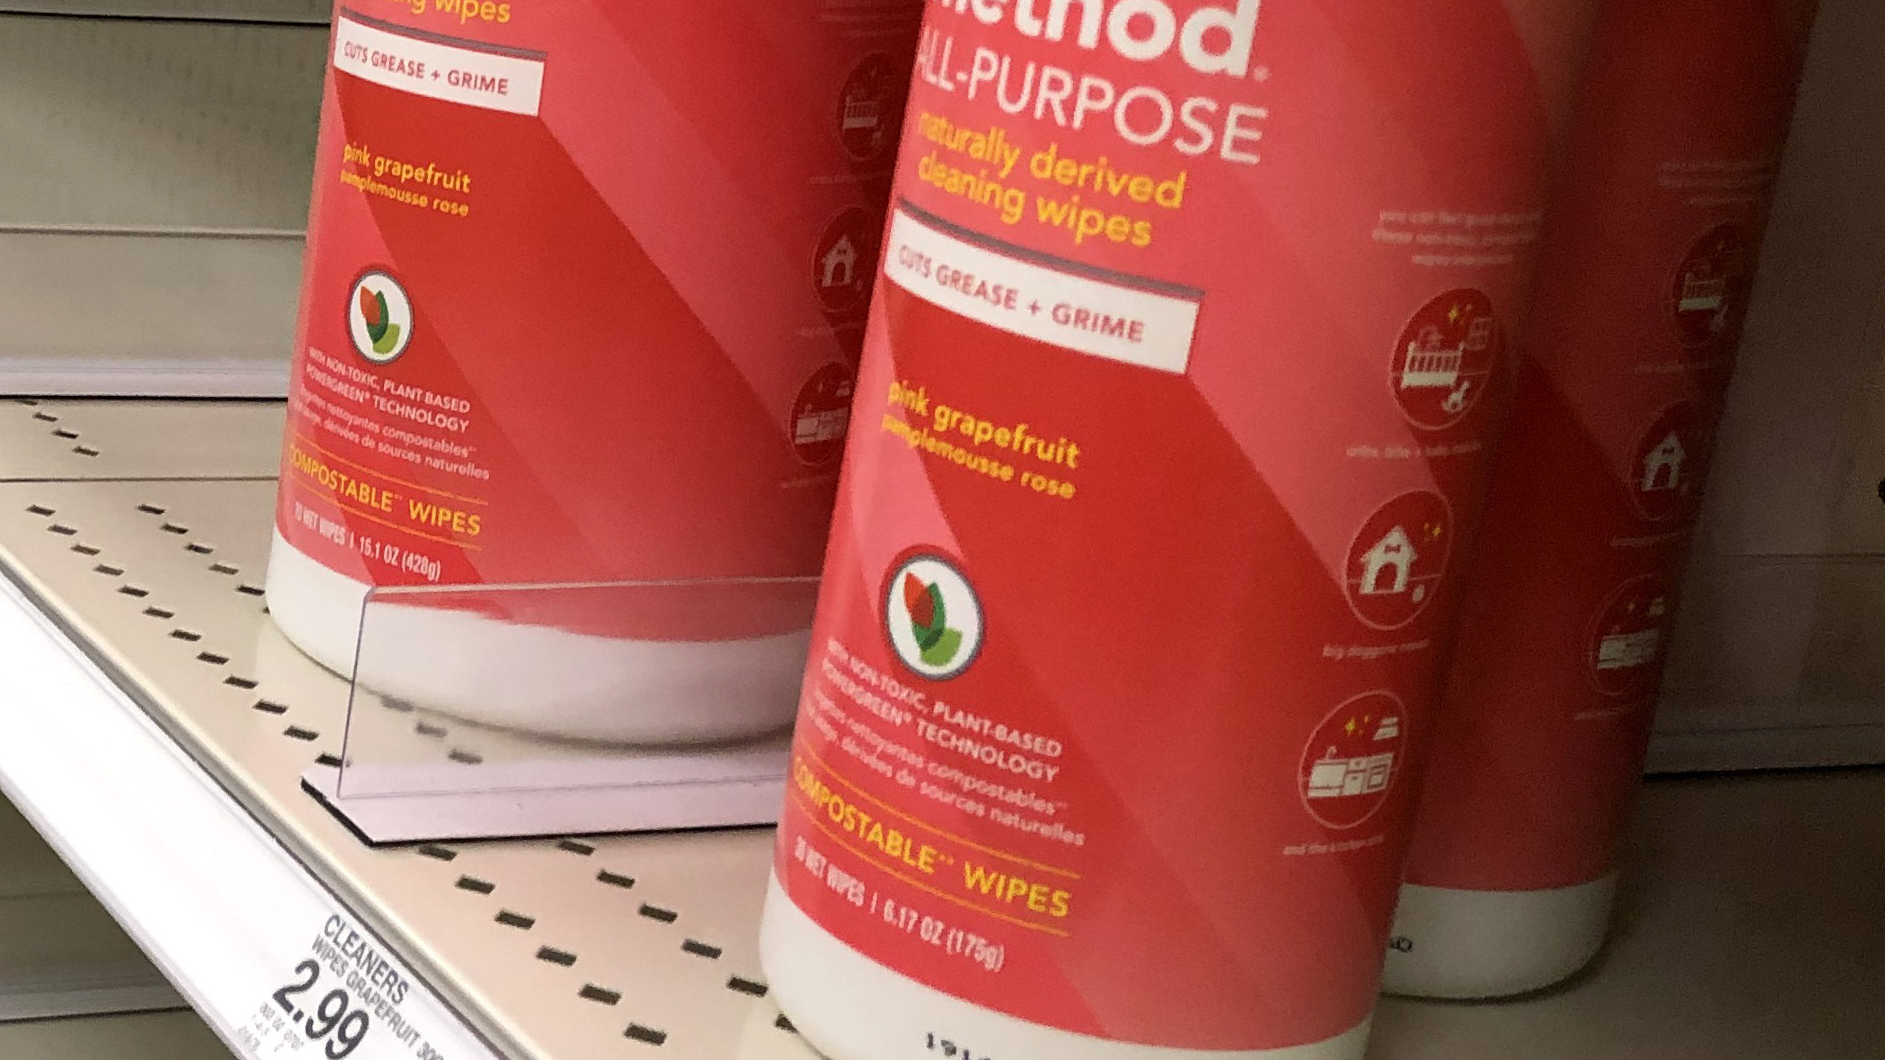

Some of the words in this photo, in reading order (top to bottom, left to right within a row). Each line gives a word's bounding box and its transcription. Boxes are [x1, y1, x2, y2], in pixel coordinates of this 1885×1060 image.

[344, 40, 368, 65] CUTS
[371, 51, 425, 79] GREASE
[431, 70, 441, 81] +
[447, 69, 509, 96] GRIME
[917, 25, 1269, 165] ALL-PURPOSE
[343, 142, 370, 167] pink
[374, 156, 471, 194] grapefruit
[919, 112, 1021, 179] naturally
[1030, 142, 1188, 210] derived
[340, 169, 428, 208] pamplemousse
[432, 198, 469, 217] rose
[919, 150, 1027, 226] cleaning
[1036, 194, 1153, 248] wipes
[898, 244, 932, 280] CUTS
[936, 262, 1020, 311] GREASE
[1028, 299, 1041, 317] +
[1052, 302, 1146, 344] GRIME
[373, 395, 470, 435] TECHNOLOGY
[888, 380, 929, 417] pink
[934, 405, 1082, 470] grapefruit
[361, 434, 376, 450] de
[377, 440, 422, 464] sources
[425, 455, 491, 481] naturelles
[1020, 471, 1077, 500] rose
[408, 498, 482, 537] WIPES
[383, 543, 400, 568] OZ
[401, 550, 442, 583] (428g)
[916, 717, 1060, 784] TECHNOLOGY
[933, 700, 1063, 759] PLANT-BASED
[989, 806, 1086, 846] naturelles
[964, 860, 1072, 918] WIPES
[324, 913, 410, 1006] CLEANERS
[884, 898, 918, 934] 6.17
[920, 915, 946, 946] OZ
[946, 927, 1005, 974] (175g)
[272, 958, 371, 1060] 2.99
[311, 933, 350, 978] WIPES
[345, 970, 422, 1049] GRAPEFRUIT
